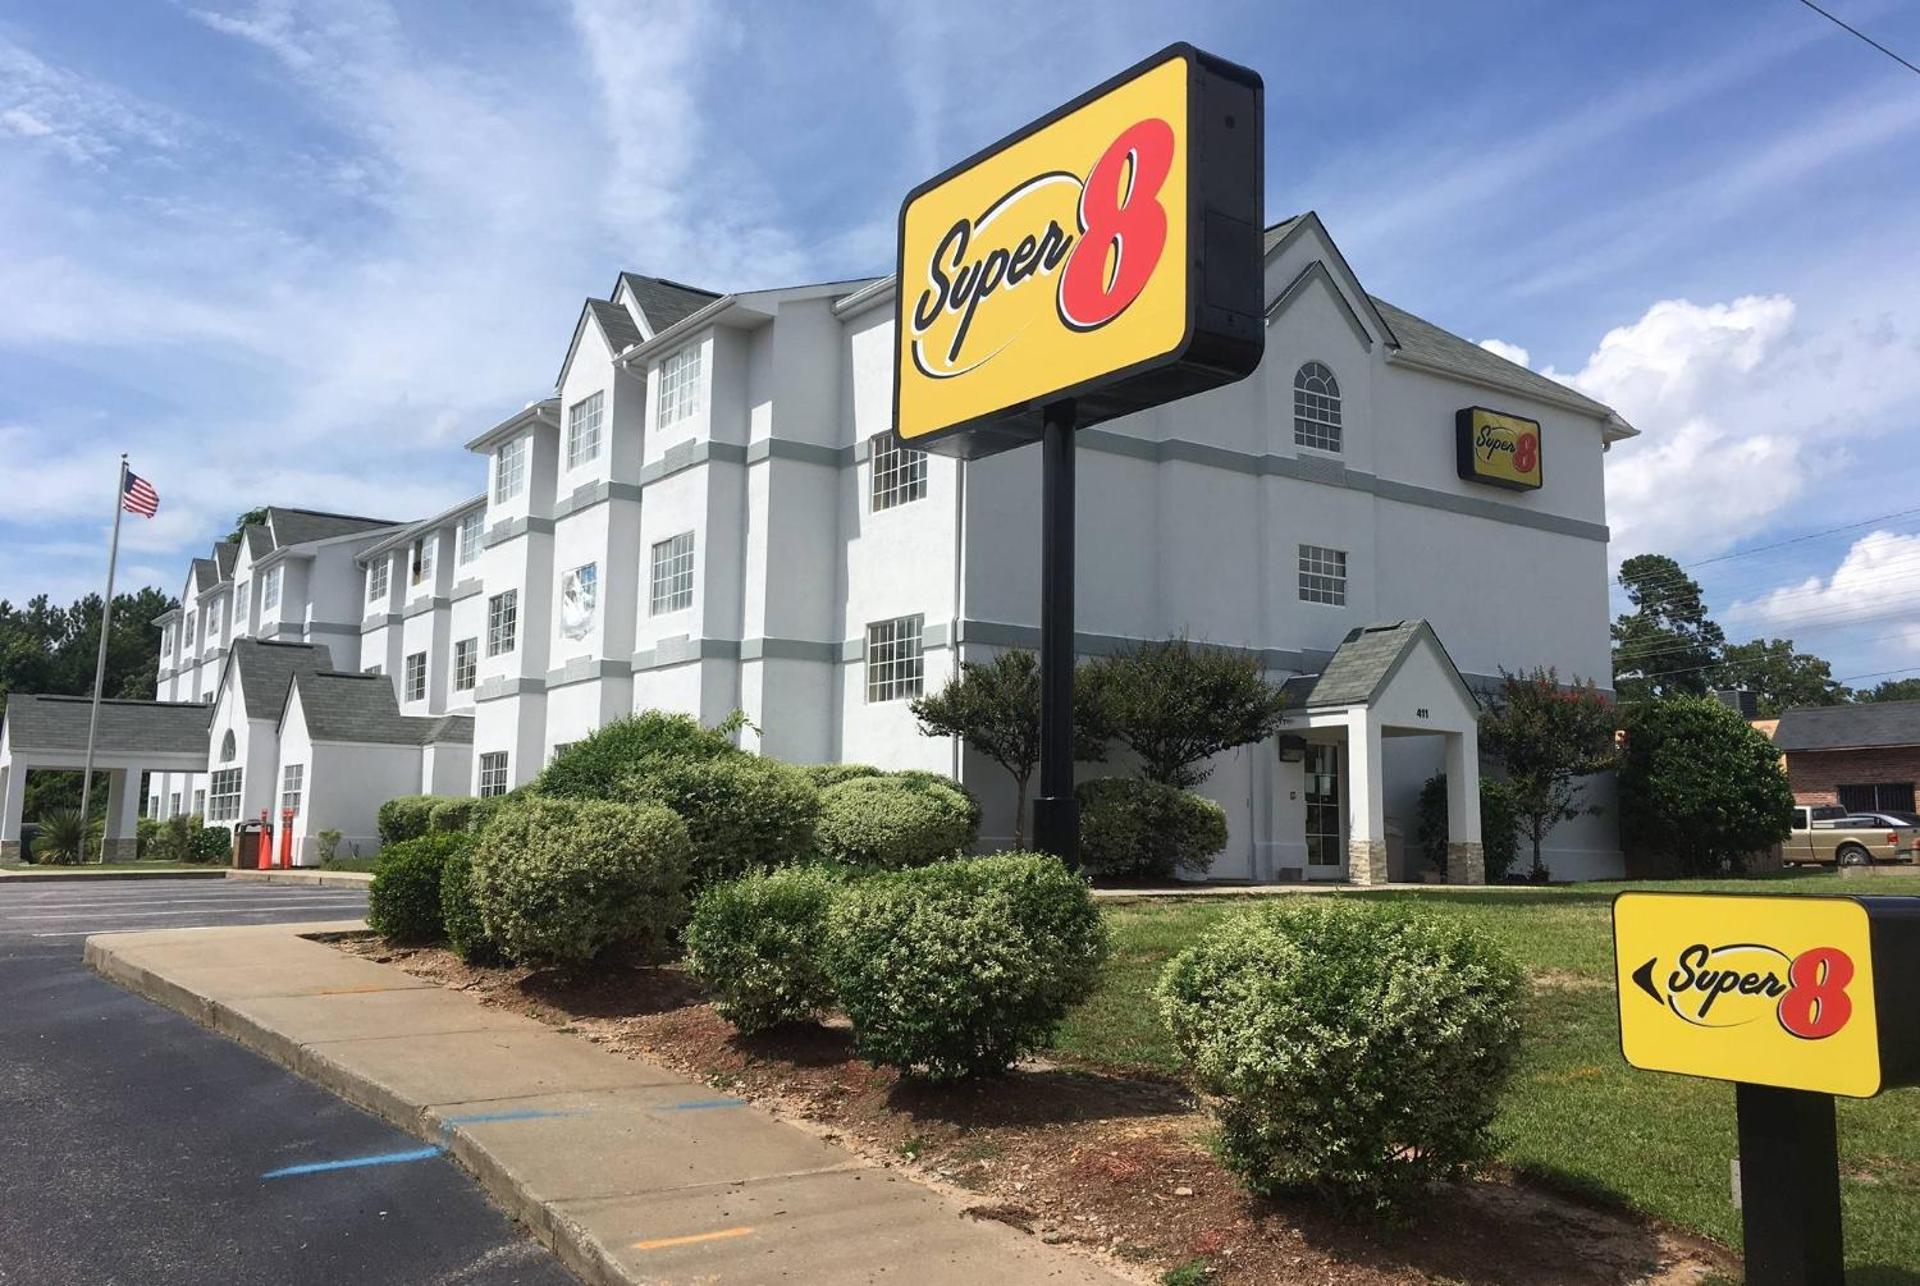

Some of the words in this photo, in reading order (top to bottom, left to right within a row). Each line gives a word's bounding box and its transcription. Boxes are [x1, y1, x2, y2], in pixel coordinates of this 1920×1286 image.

[914, 218, 1074, 363] Super
[1056, 117, 1175, 333] 8
[1476, 425, 1516, 460] Super
[1513, 433, 1537, 473] 8
[1416, 708, 1429, 719] 411
[1668, 943, 1787, 1019] Super
[1776, 946, 1855, 1040] 8
